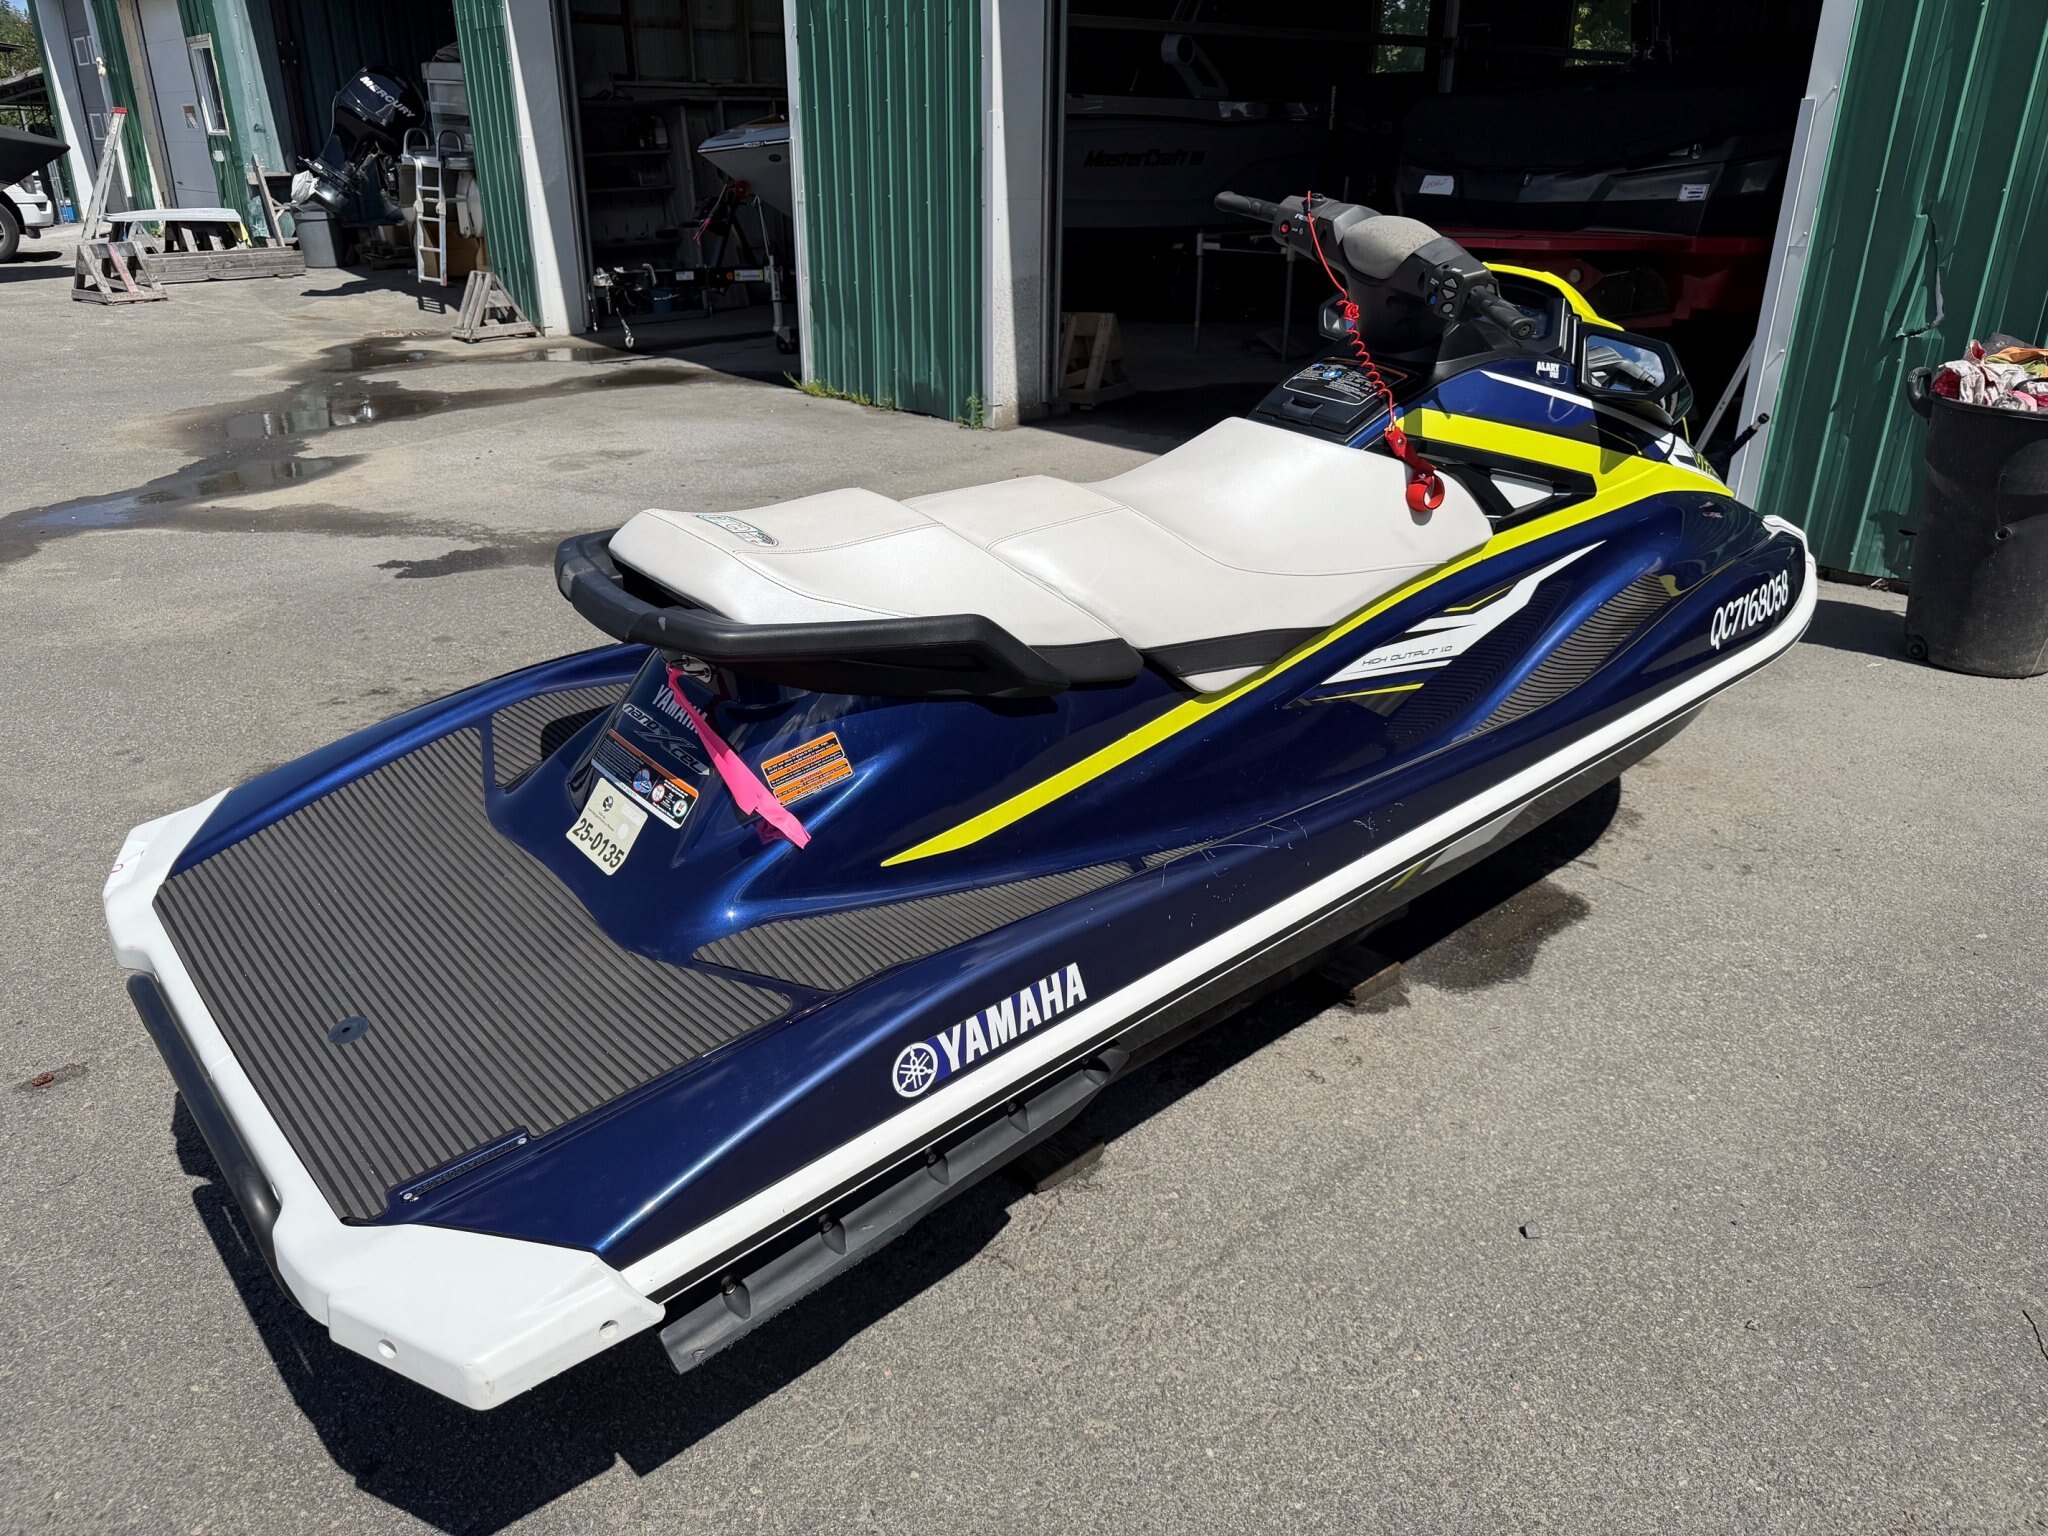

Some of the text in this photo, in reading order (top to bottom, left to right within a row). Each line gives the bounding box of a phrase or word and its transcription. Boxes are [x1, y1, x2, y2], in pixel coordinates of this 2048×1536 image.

[360, 76, 415, 117] MERCURY
[1084, 149, 1188, 168] MasterCraft
[1710, 569, 1788, 650] QC7168058
[1390, 648, 1438, 661] OUTPUT
[572, 817, 625, 868] 25-0135
[936, 962, 1088, 1072] YAMAHA
